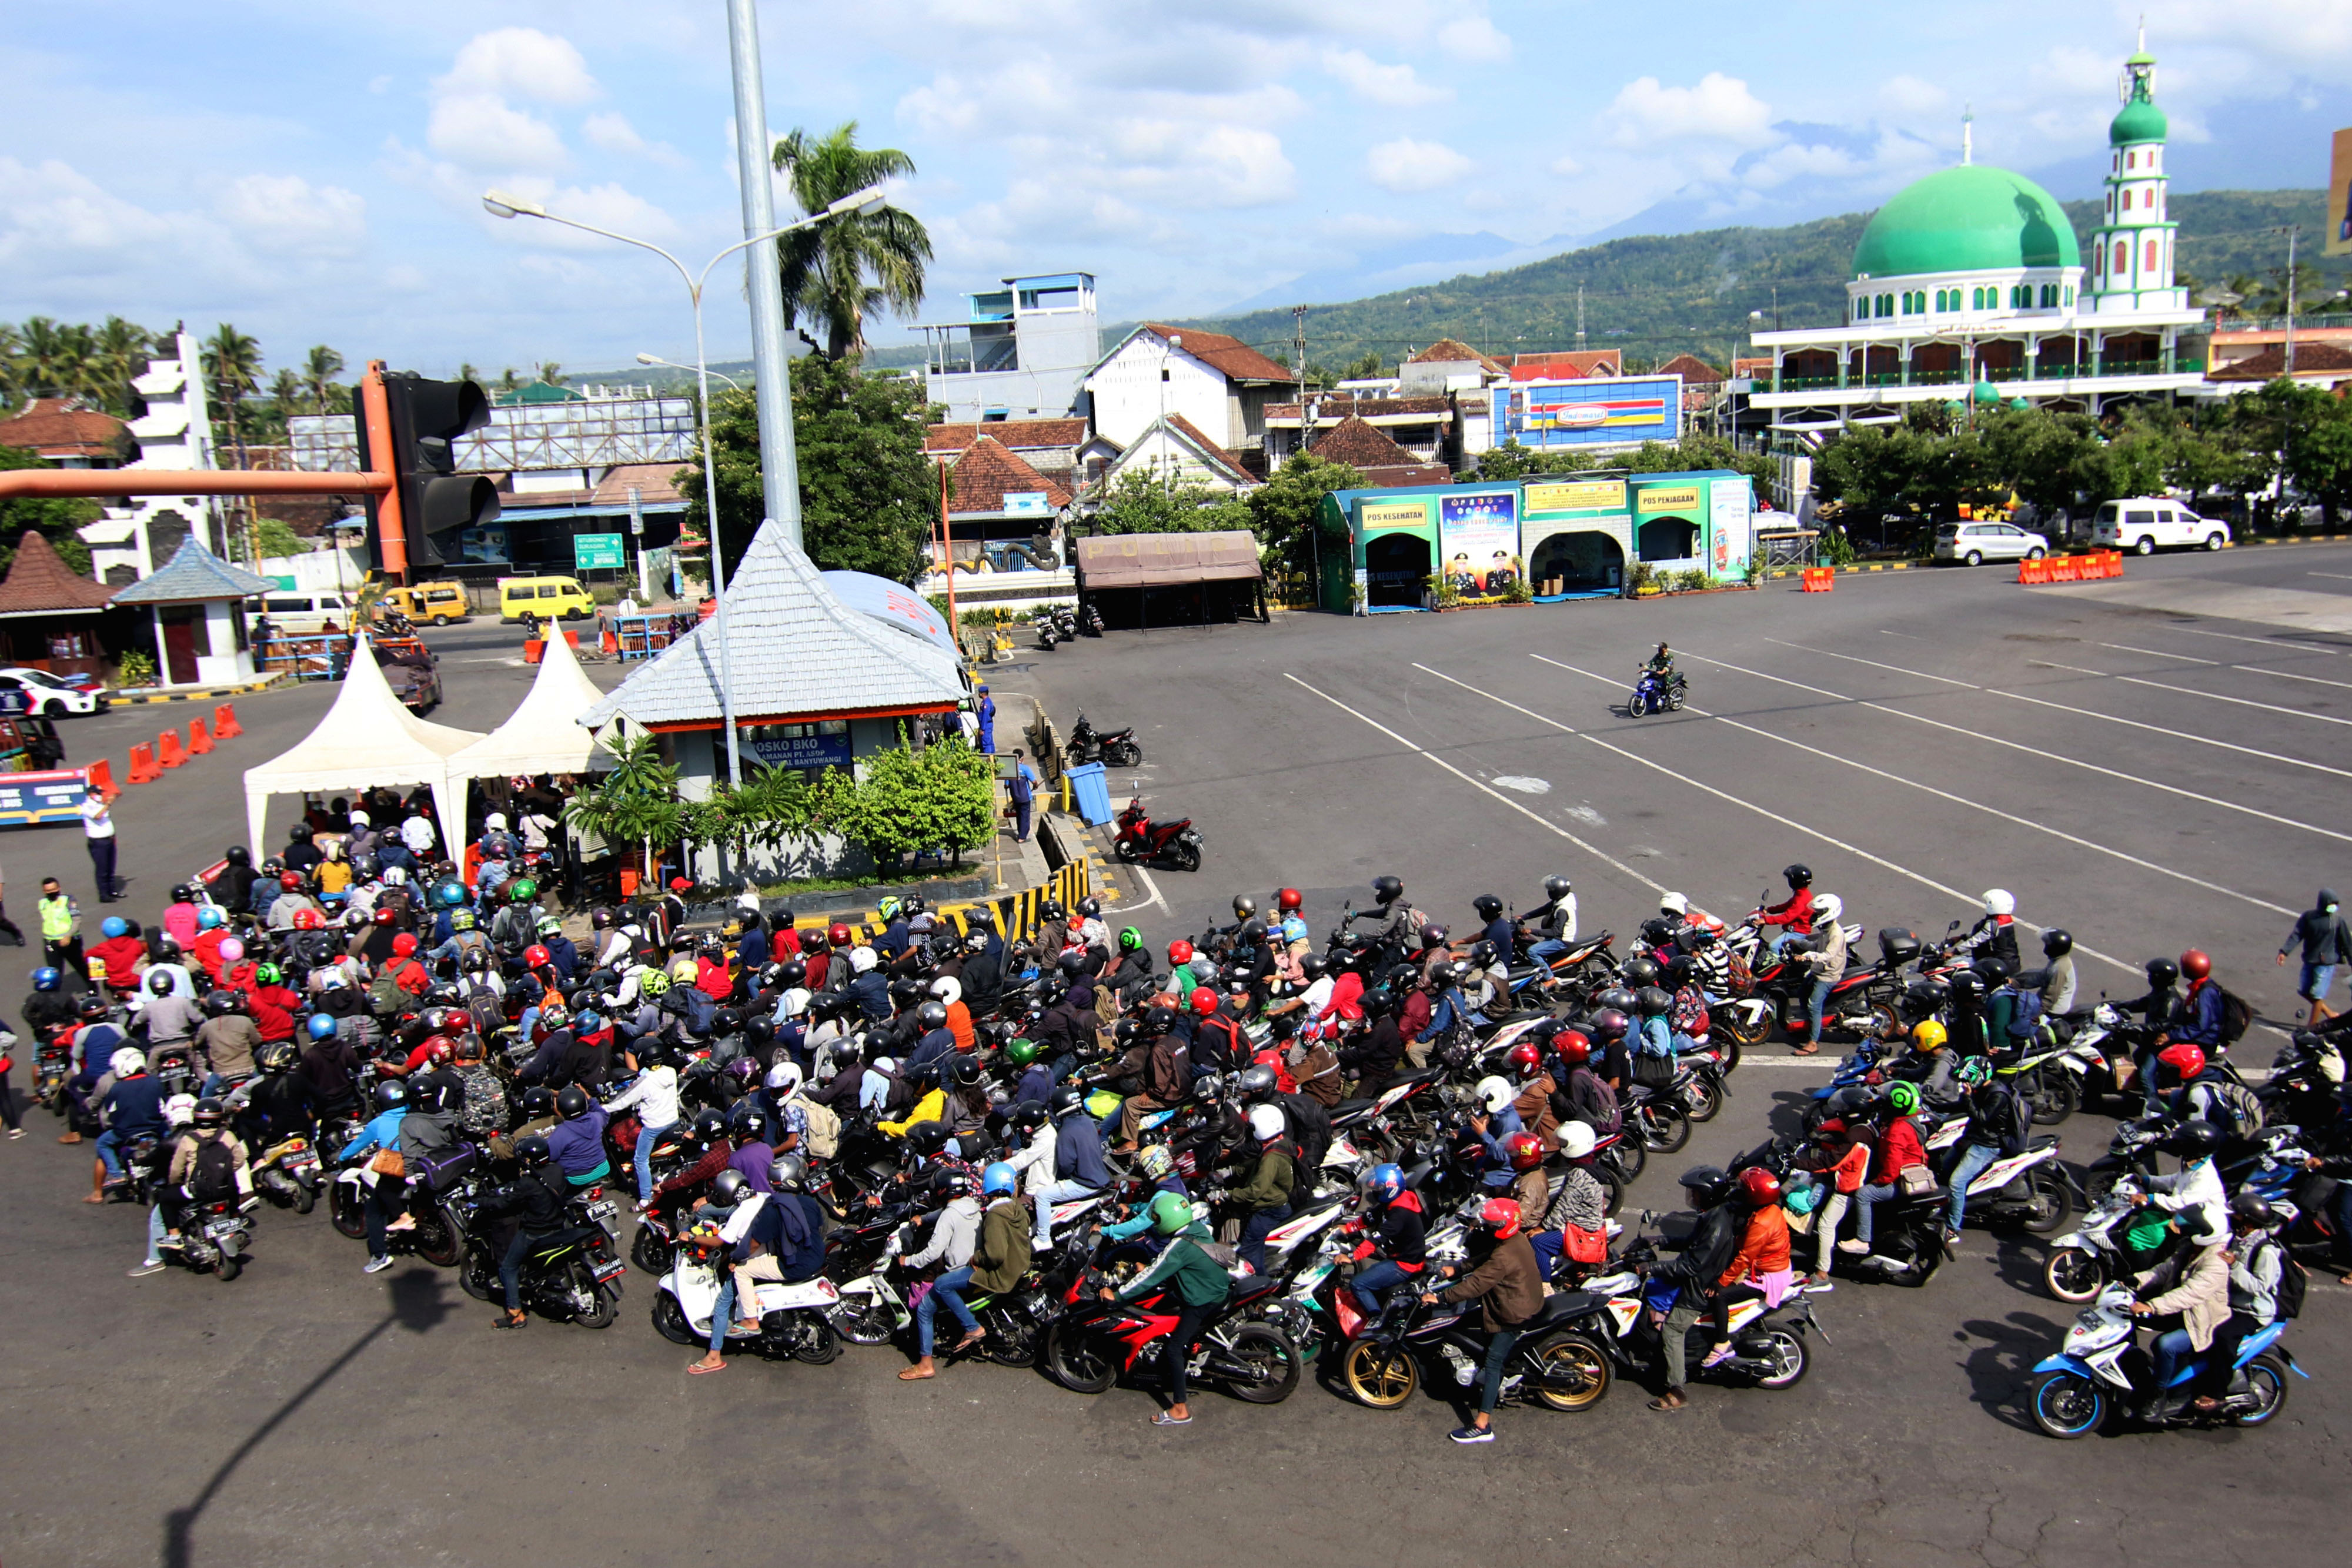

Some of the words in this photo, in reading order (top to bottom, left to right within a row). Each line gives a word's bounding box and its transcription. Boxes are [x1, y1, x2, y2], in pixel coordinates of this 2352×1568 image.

[1561, 411, 1604, 420] Indomaret
[1658, 495, 1694, 504] PENJAGAAN
[1384, 511, 1422, 520] KESEHATAN
[1088, 537, 1250, 559] POLISI
[755, 740, 789, 752] OSKO
[793, 738, 818, 750] BKO
[795, 756, 841, 765] BANYUWANGI
